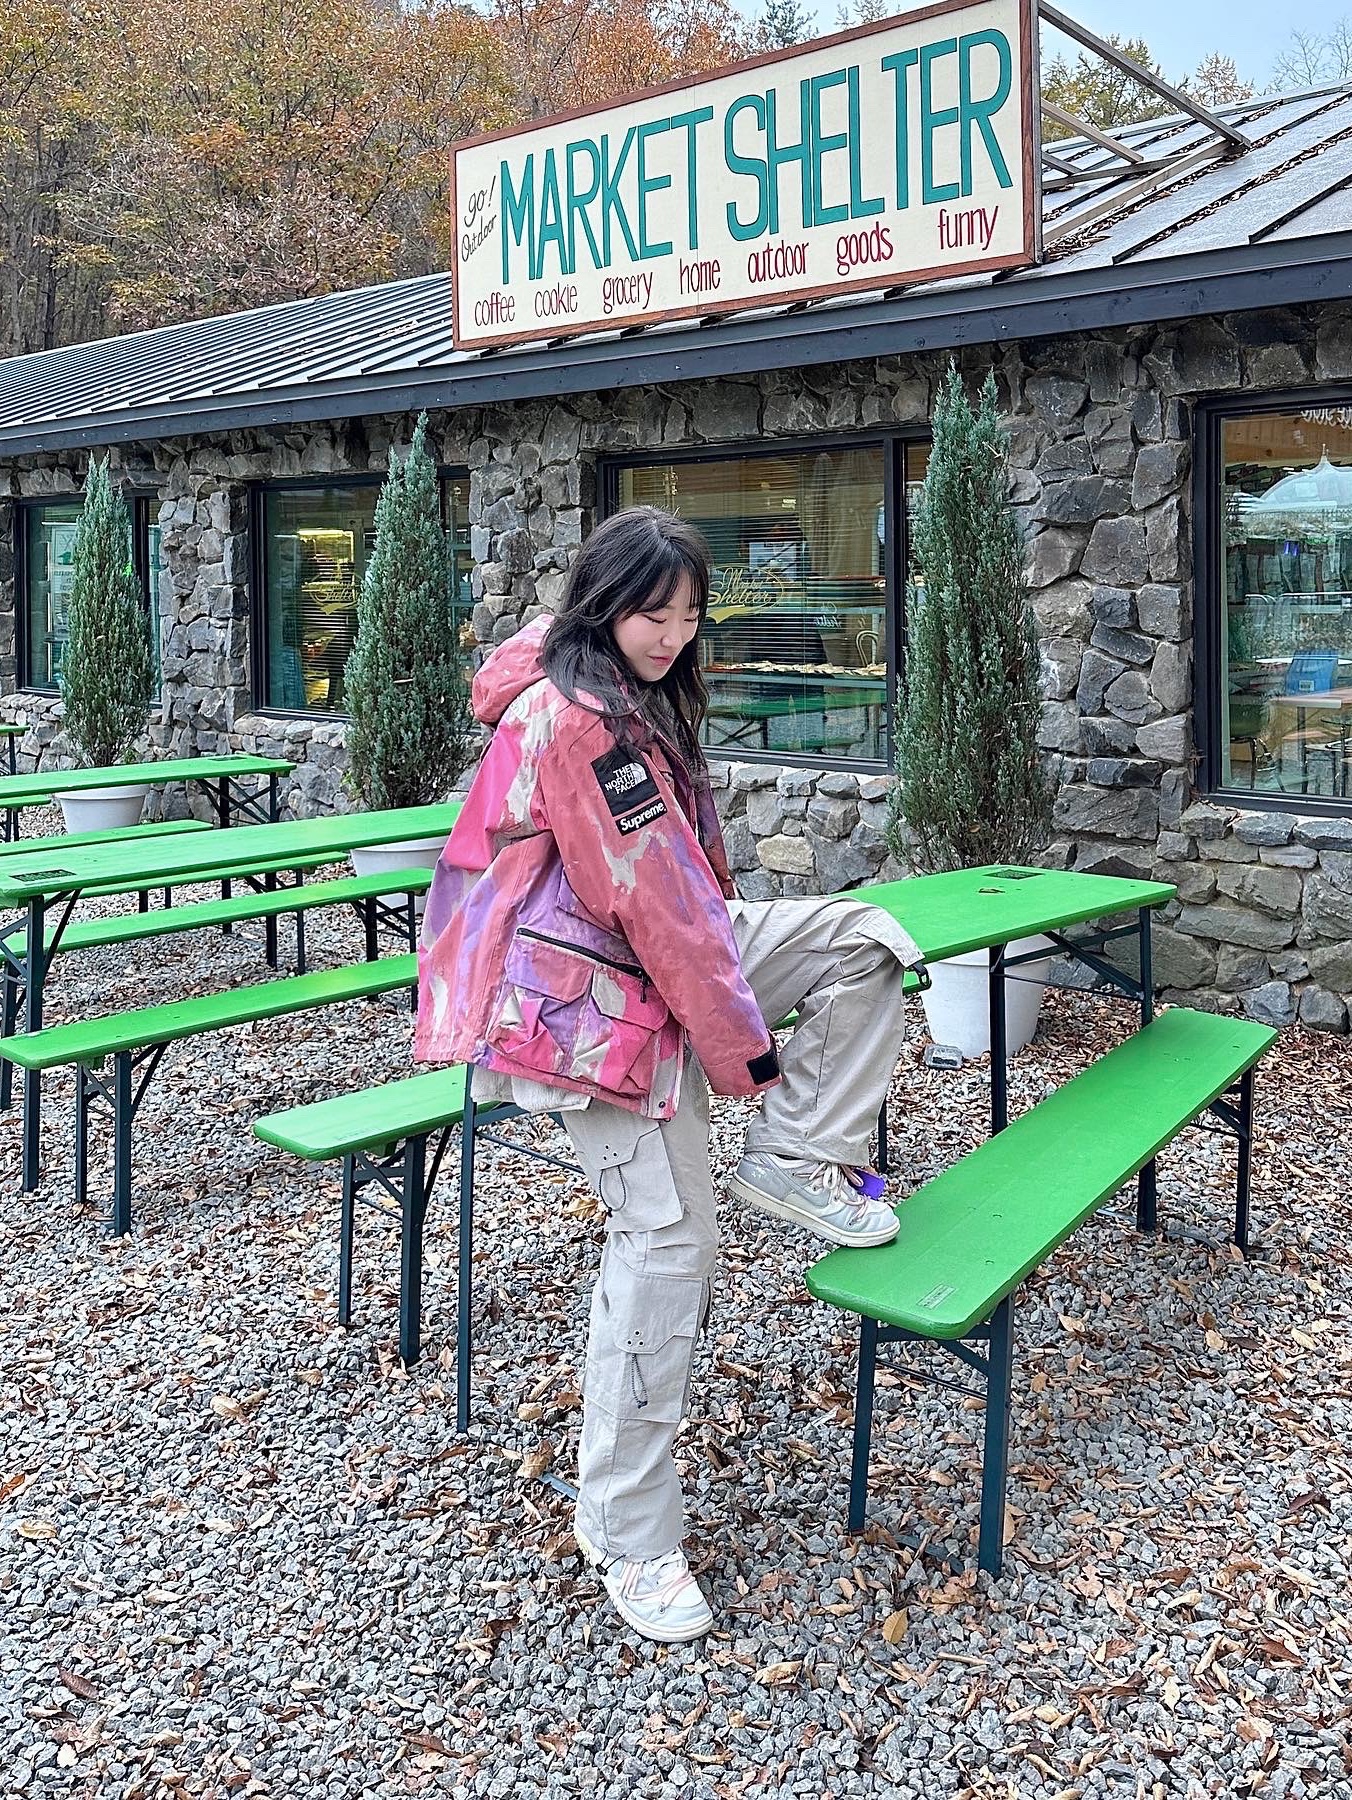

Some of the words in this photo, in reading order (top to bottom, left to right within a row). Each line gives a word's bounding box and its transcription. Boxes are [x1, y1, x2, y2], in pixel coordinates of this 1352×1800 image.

[501, 105, 714, 285] MARKET
[724, 28, 1013, 242] SHELTER
[463, 174, 497, 228] go!
[474, 291, 516, 327] coffee
[534, 282, 578, 318] cookie
[602, 271, 654, 315] grocery
[679, 257, 721, 295] home
[748, 240, 809, 284] outdoor
[836, 220, 894, 276] goods
[937, 204, 999, 251] funny
[604, 771, 634, 791] NORTH
[612, 764, 632, 778] THE
[614, 780, 636, 795] FACE
[619, 802, 666, 831] Supreme
